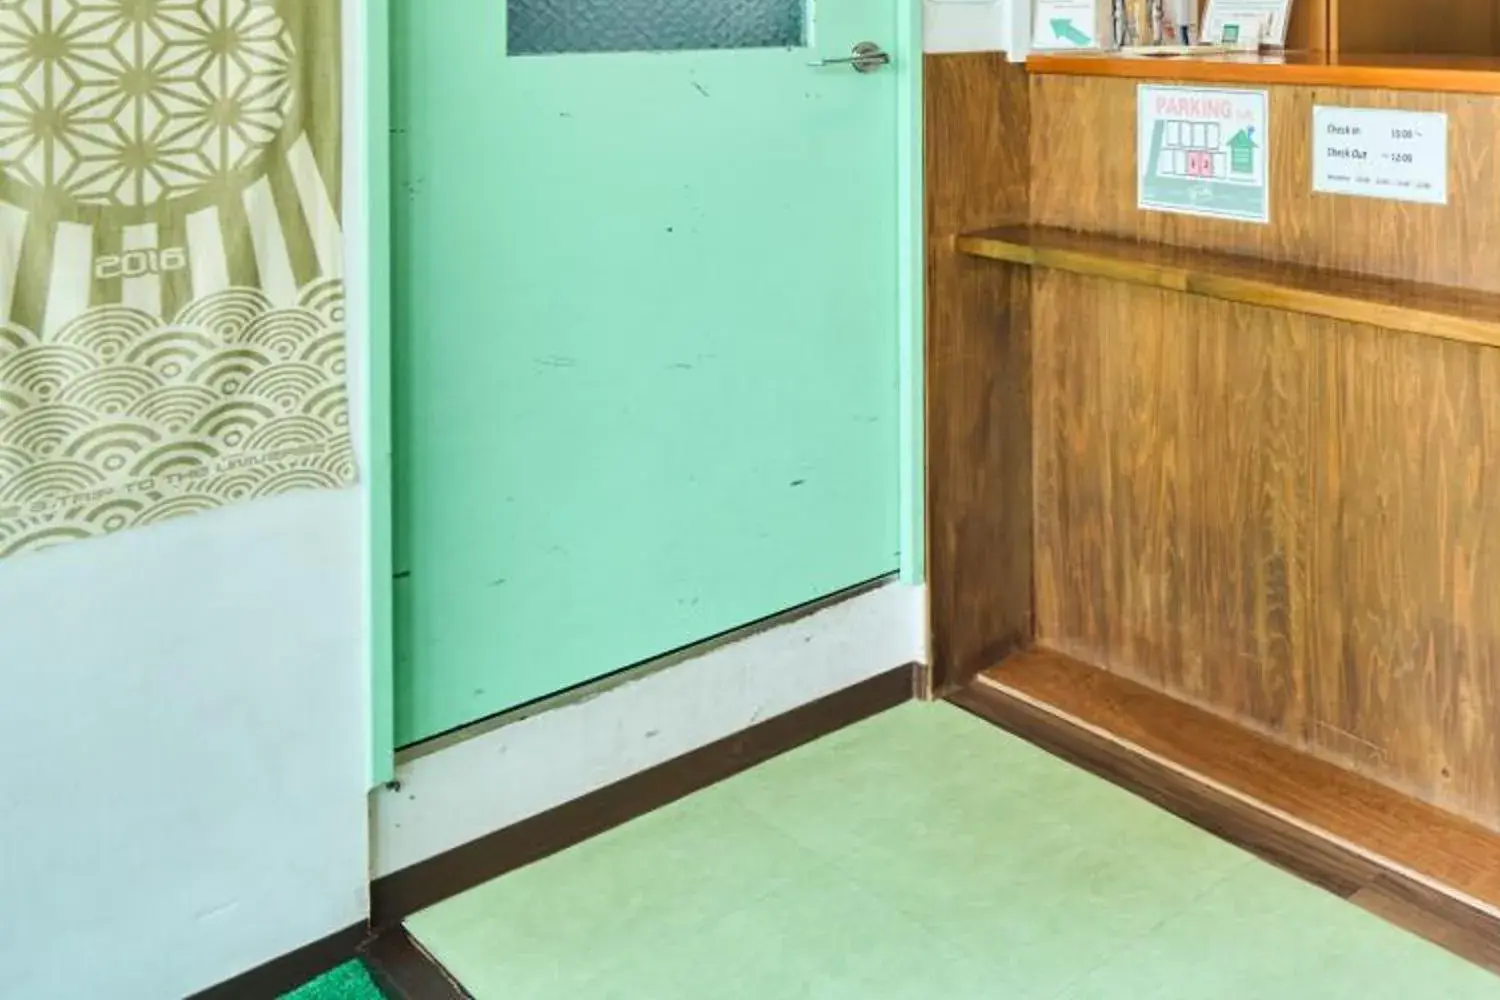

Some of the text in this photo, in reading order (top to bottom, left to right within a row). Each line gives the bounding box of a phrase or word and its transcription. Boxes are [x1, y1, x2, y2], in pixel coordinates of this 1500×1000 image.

[1156, 96, 1232, 119] PARKING
[1327, 123, 1350, 135] Check
[1327, 147, 1367, 159] Check Out
[95, 247, 186, 279] 2016
